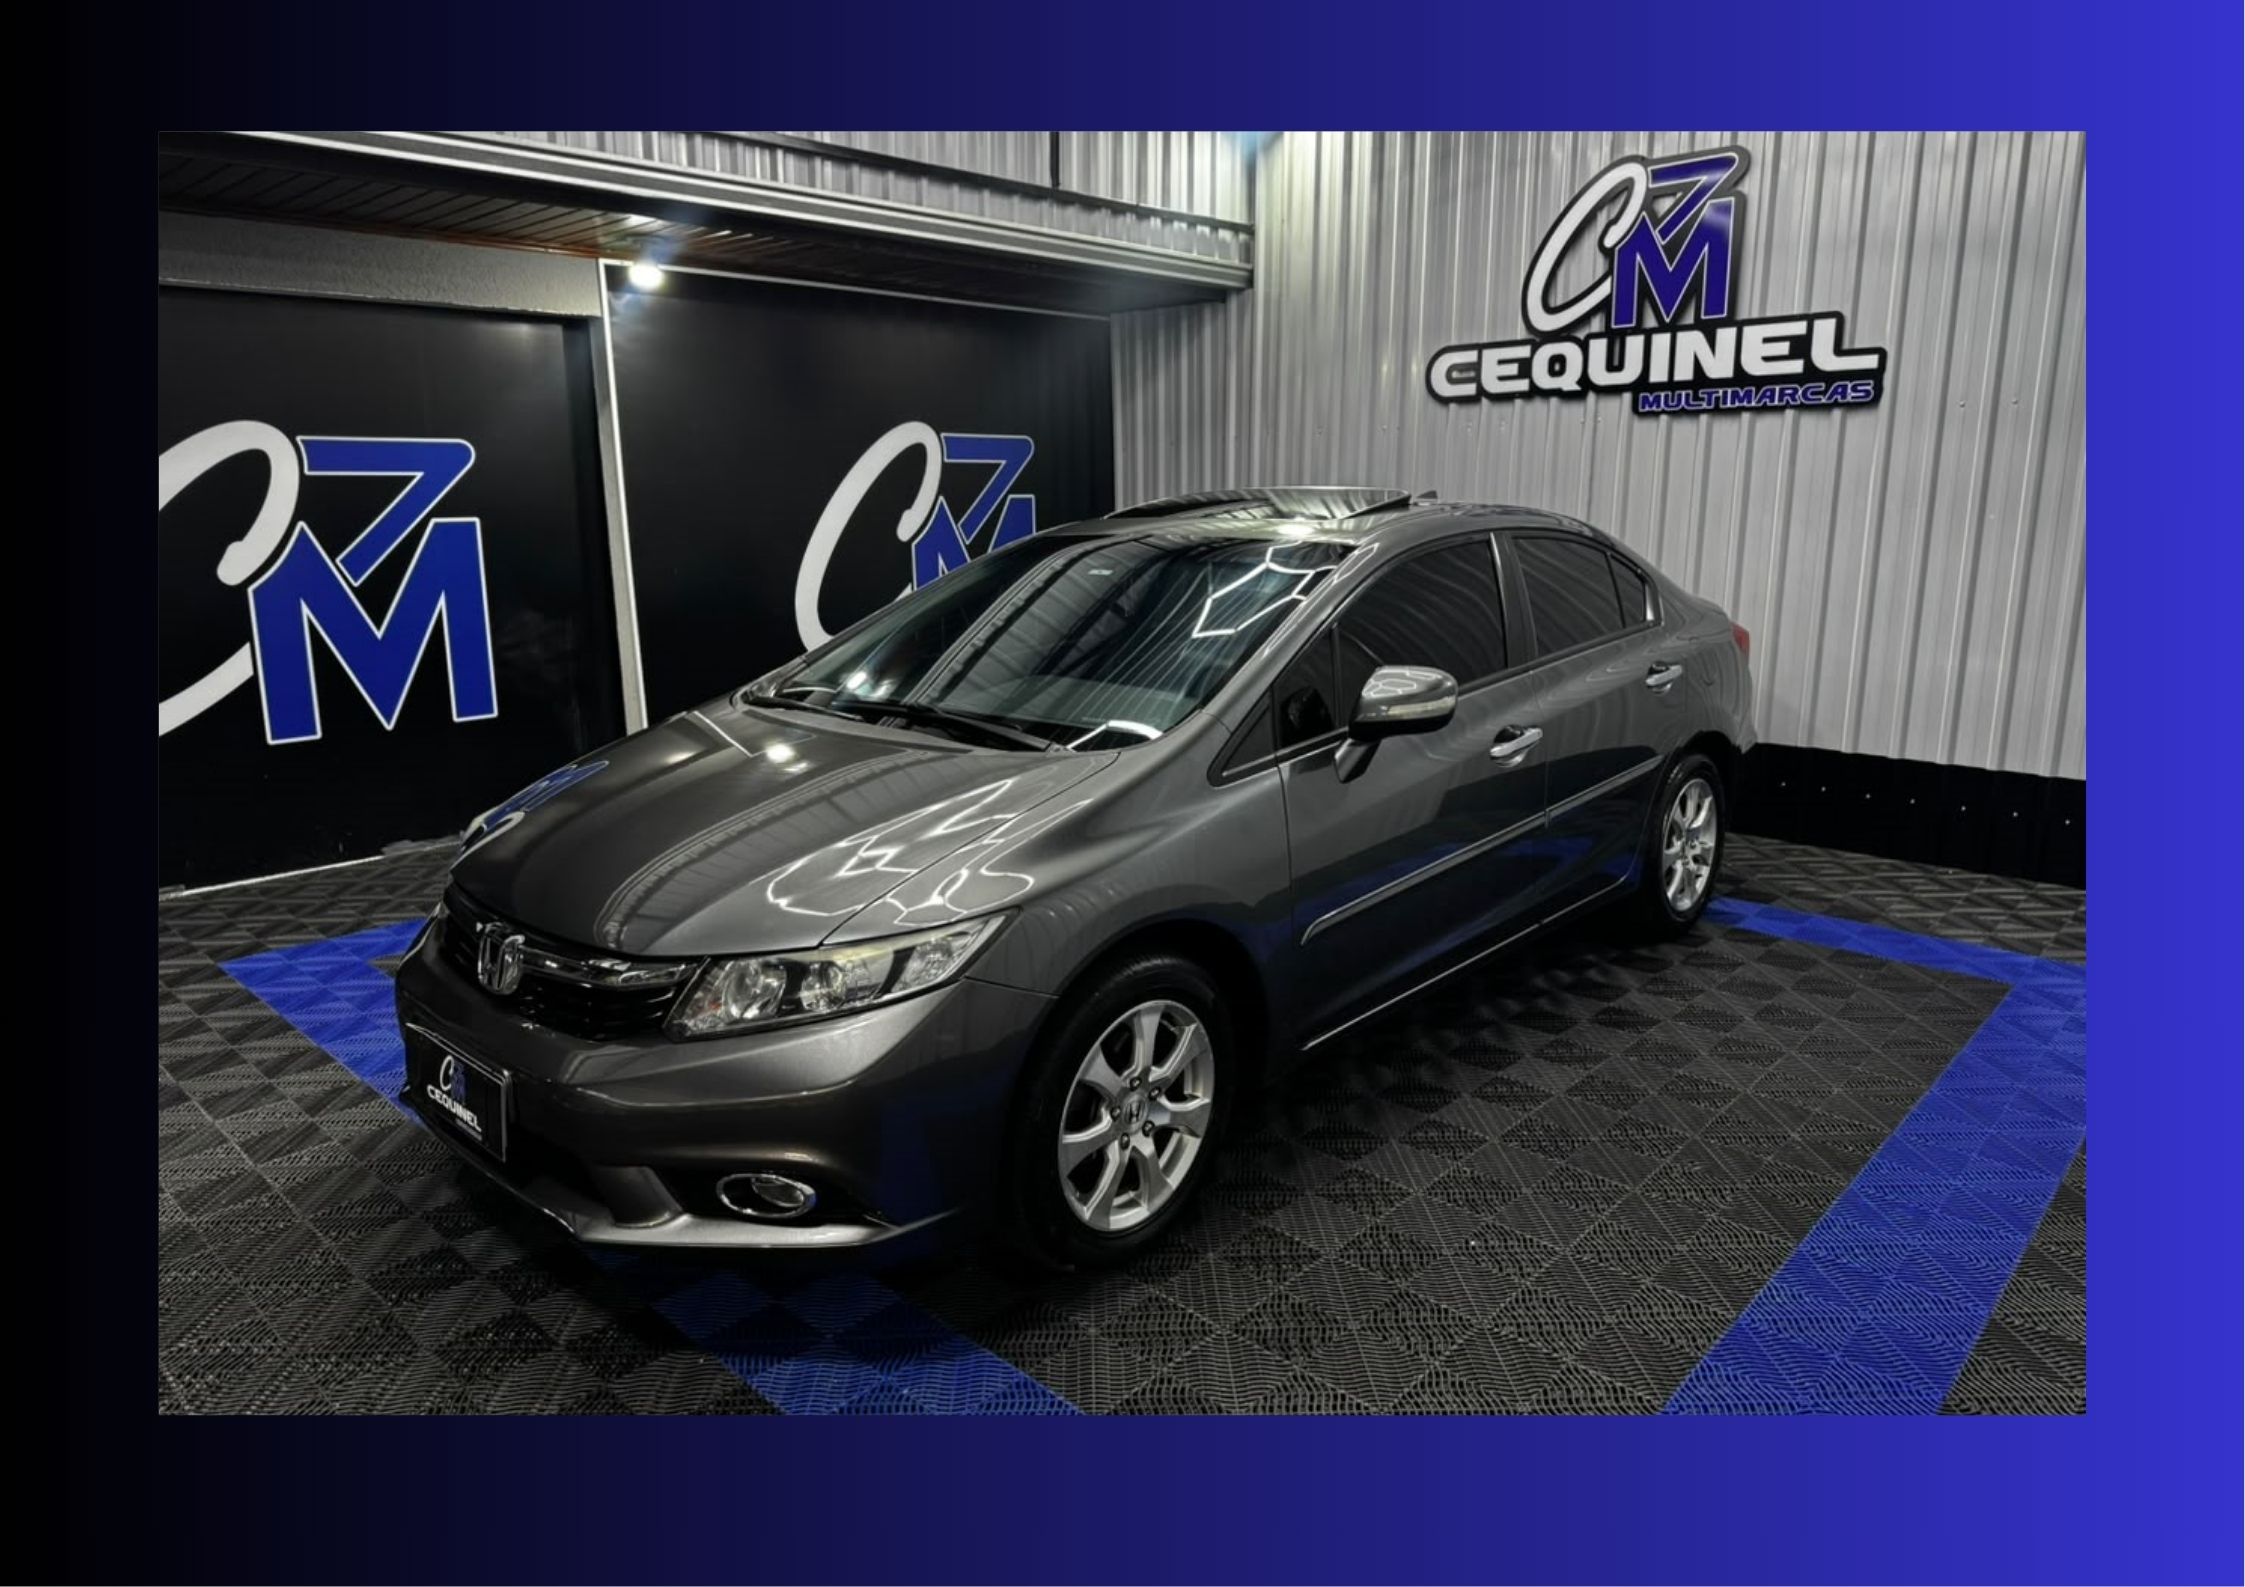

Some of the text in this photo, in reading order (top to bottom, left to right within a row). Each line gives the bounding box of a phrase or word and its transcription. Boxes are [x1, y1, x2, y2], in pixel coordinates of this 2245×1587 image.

[1430, 318, 1880, 398] CEQUINEL
[1638, 380, 1876, 412] MULTIMARCAS
[427, 1084, 482, 1132] CEQUINEL
